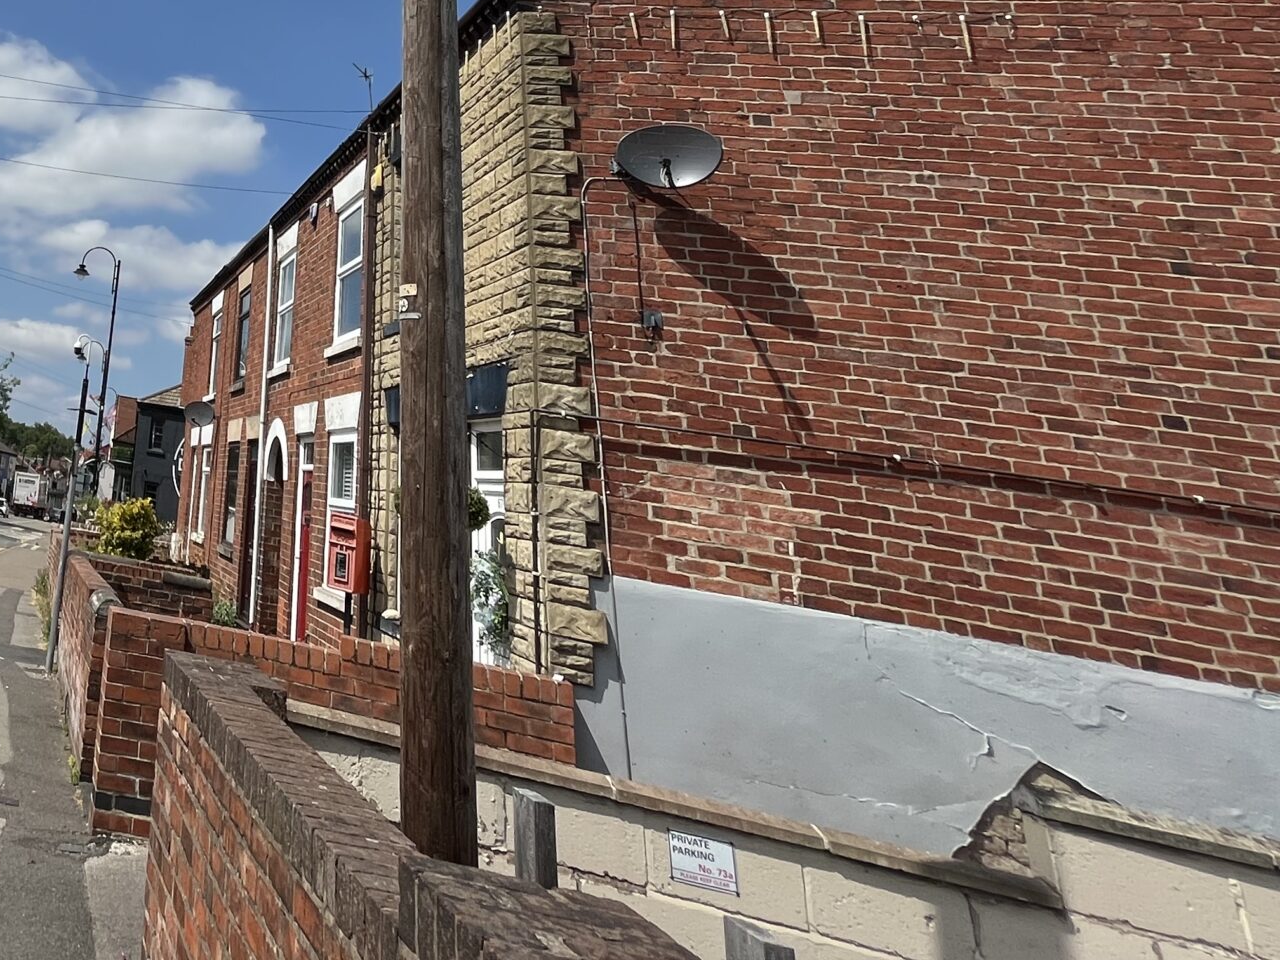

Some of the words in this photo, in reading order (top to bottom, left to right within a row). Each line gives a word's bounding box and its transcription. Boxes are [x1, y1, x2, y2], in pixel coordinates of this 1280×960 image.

[671, 833, 710, 849] PRIVATE
[672, 846, 714, 862] PARKING
[717, 868, 734, 880] 73a
